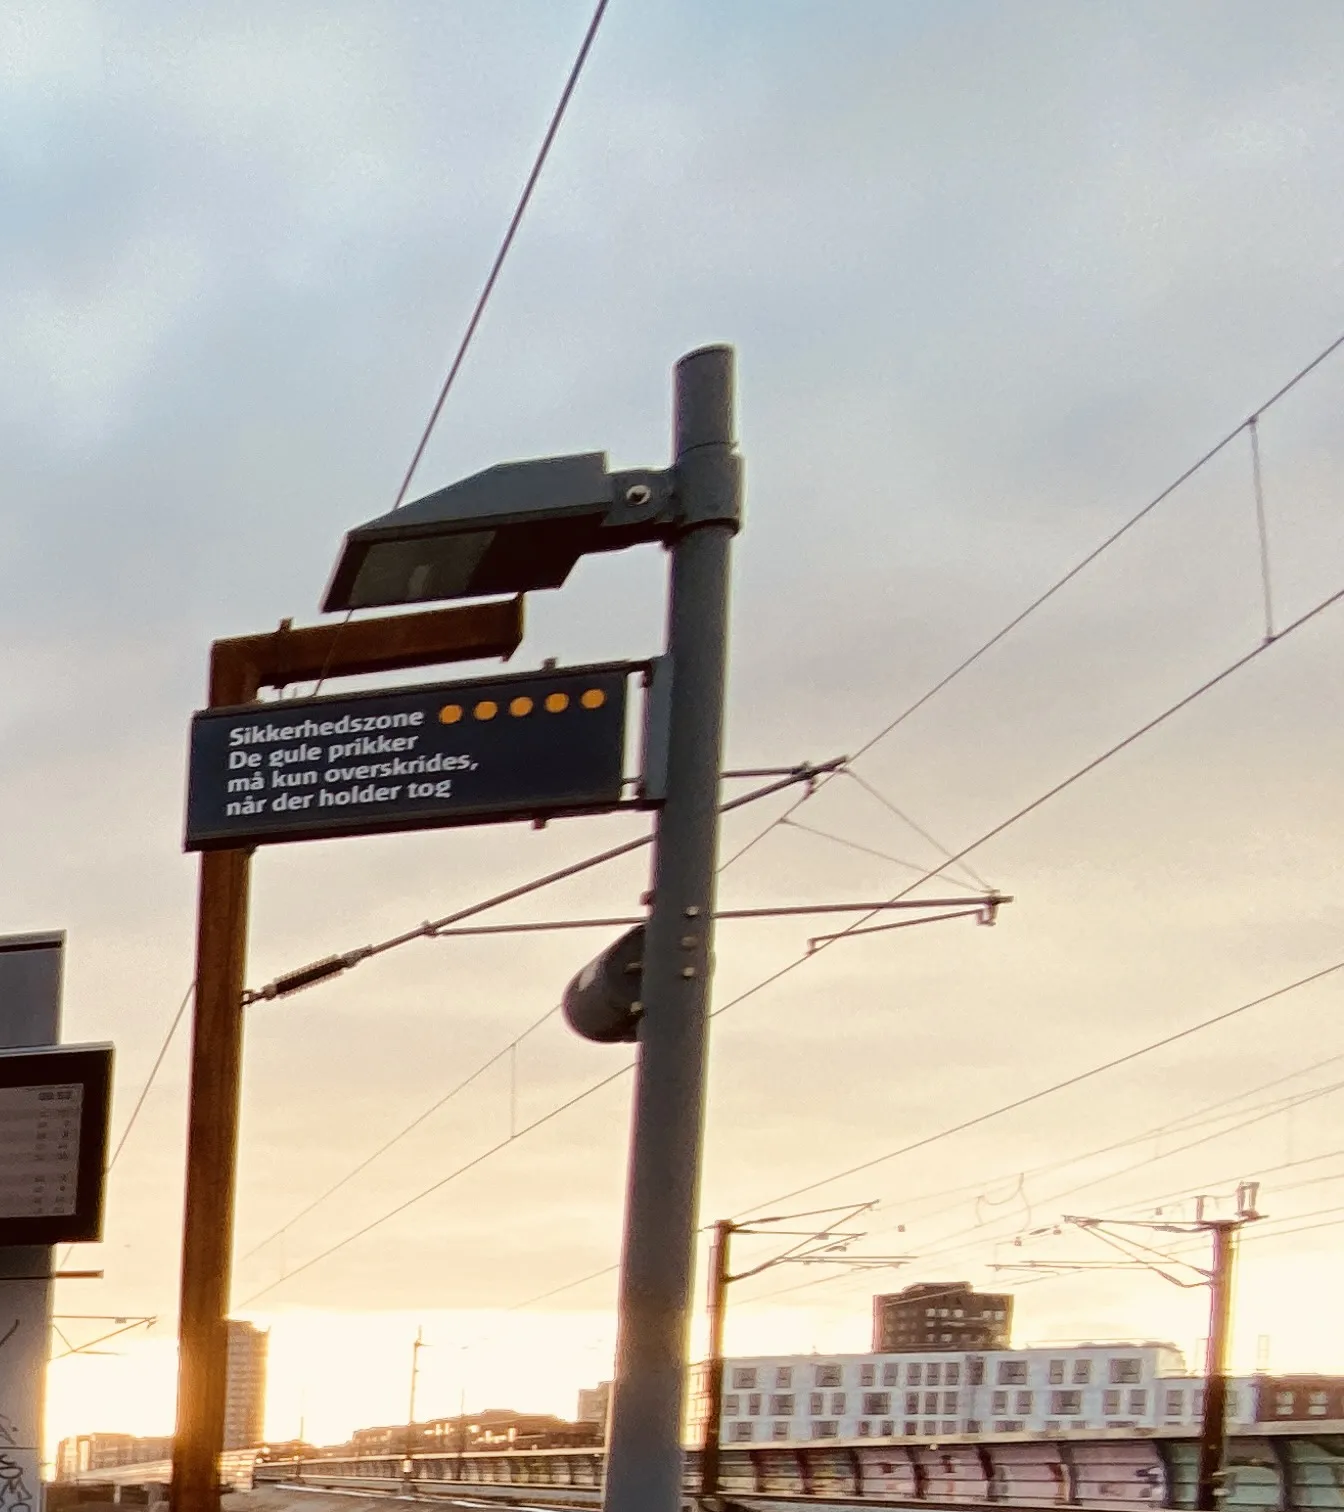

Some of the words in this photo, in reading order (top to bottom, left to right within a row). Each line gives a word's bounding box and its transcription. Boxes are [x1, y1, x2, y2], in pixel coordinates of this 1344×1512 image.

[229, 710, 425, 746] Sikkerhedszone
[228, 751, 262, 770] De
[269, 743, 322, 767] gule
[328, 735, 419, 763] prikker
[227, 772, 265, 793] må
[272, 770, 317, 788] kun
[324, 752, 478, 783] overskrides,
[226, 795, 267, 816] når
[272, 793, 314, 811] der
[319, 784, 402, 807] holder
[407, 779, 452, 798] tog
